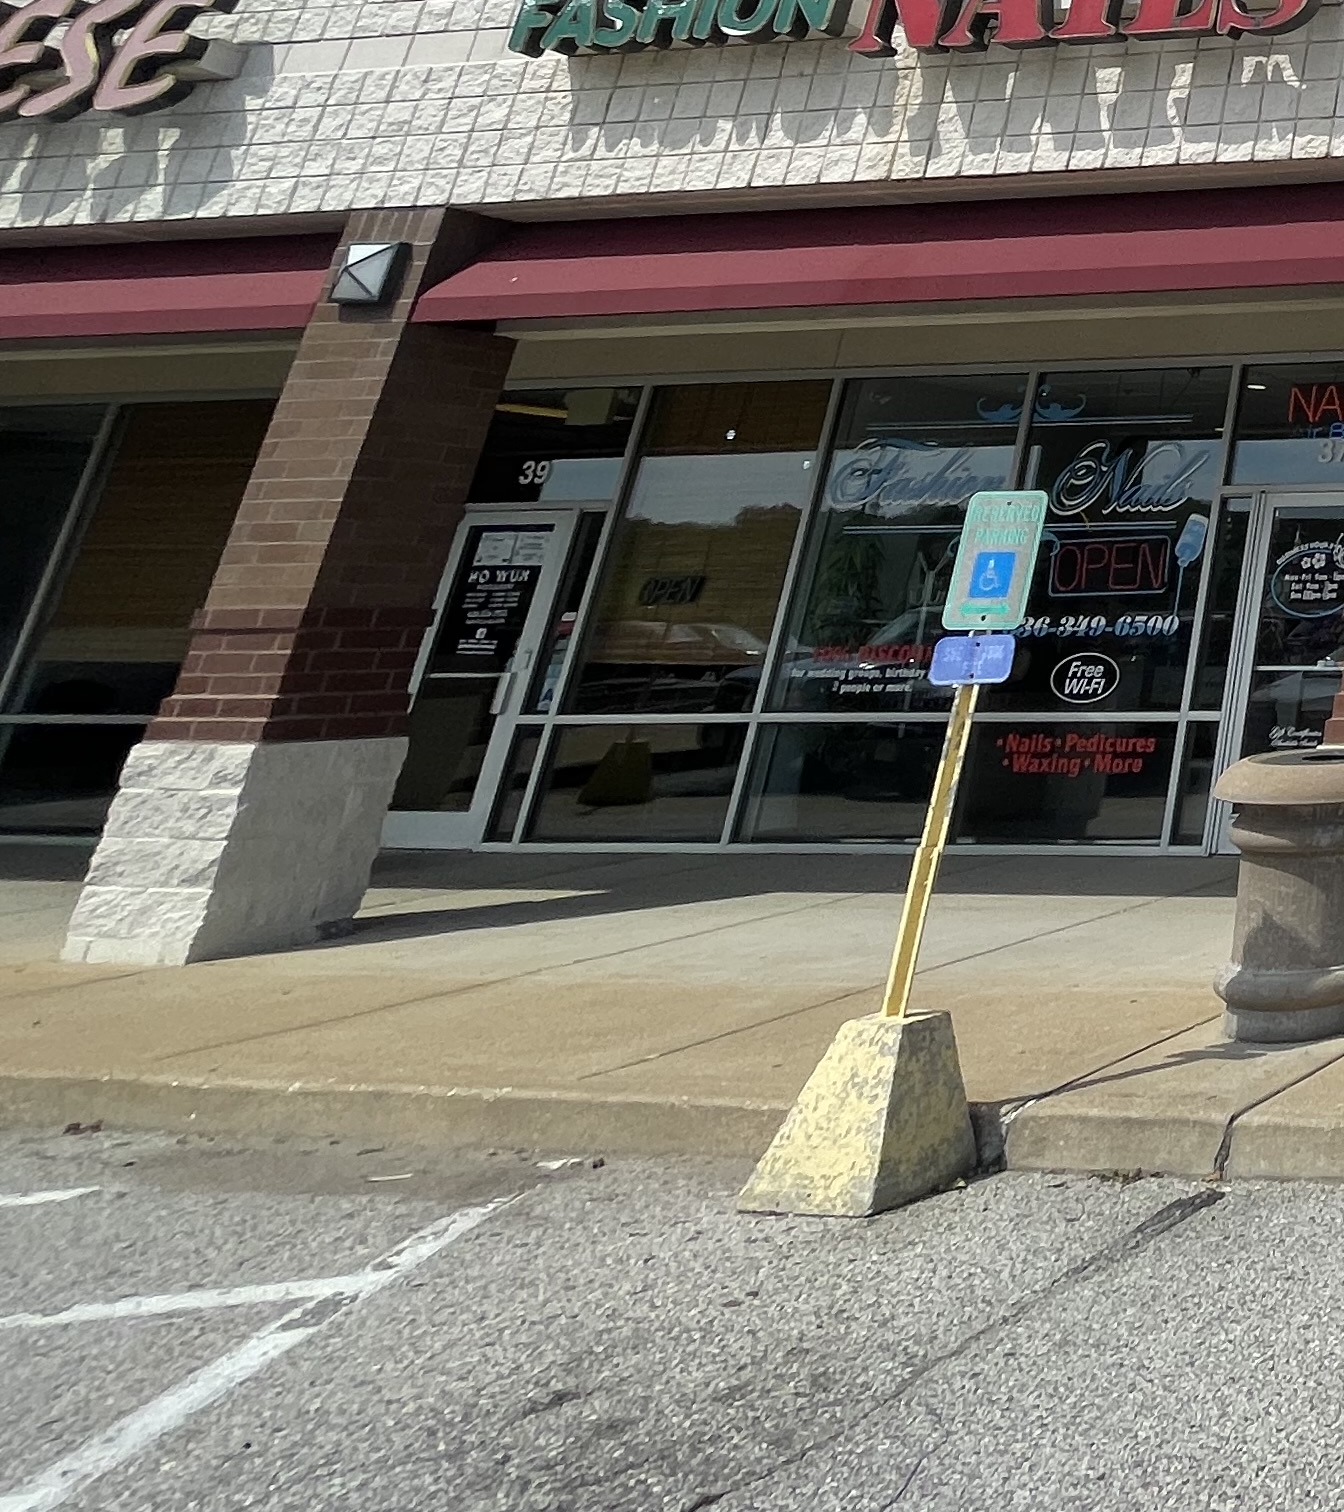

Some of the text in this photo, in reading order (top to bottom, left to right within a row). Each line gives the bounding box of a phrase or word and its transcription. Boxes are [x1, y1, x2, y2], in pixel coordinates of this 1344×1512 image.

[519, 461, 549, 484] 39
[973, 503, 1042, 523] RESERVED
[976, 527, 1030, 546] PARKING
[1054, 542, 1167, 591] OPEN
[641, 577, 703, 605] OPEN
[1015, 614, 1180, 638] 36-349-6500
[1068, 661, 1105, 678] Free
[1064, 732, 1157, 754] Pedicures
[1012, 753, 1144, 777] Waxing More
